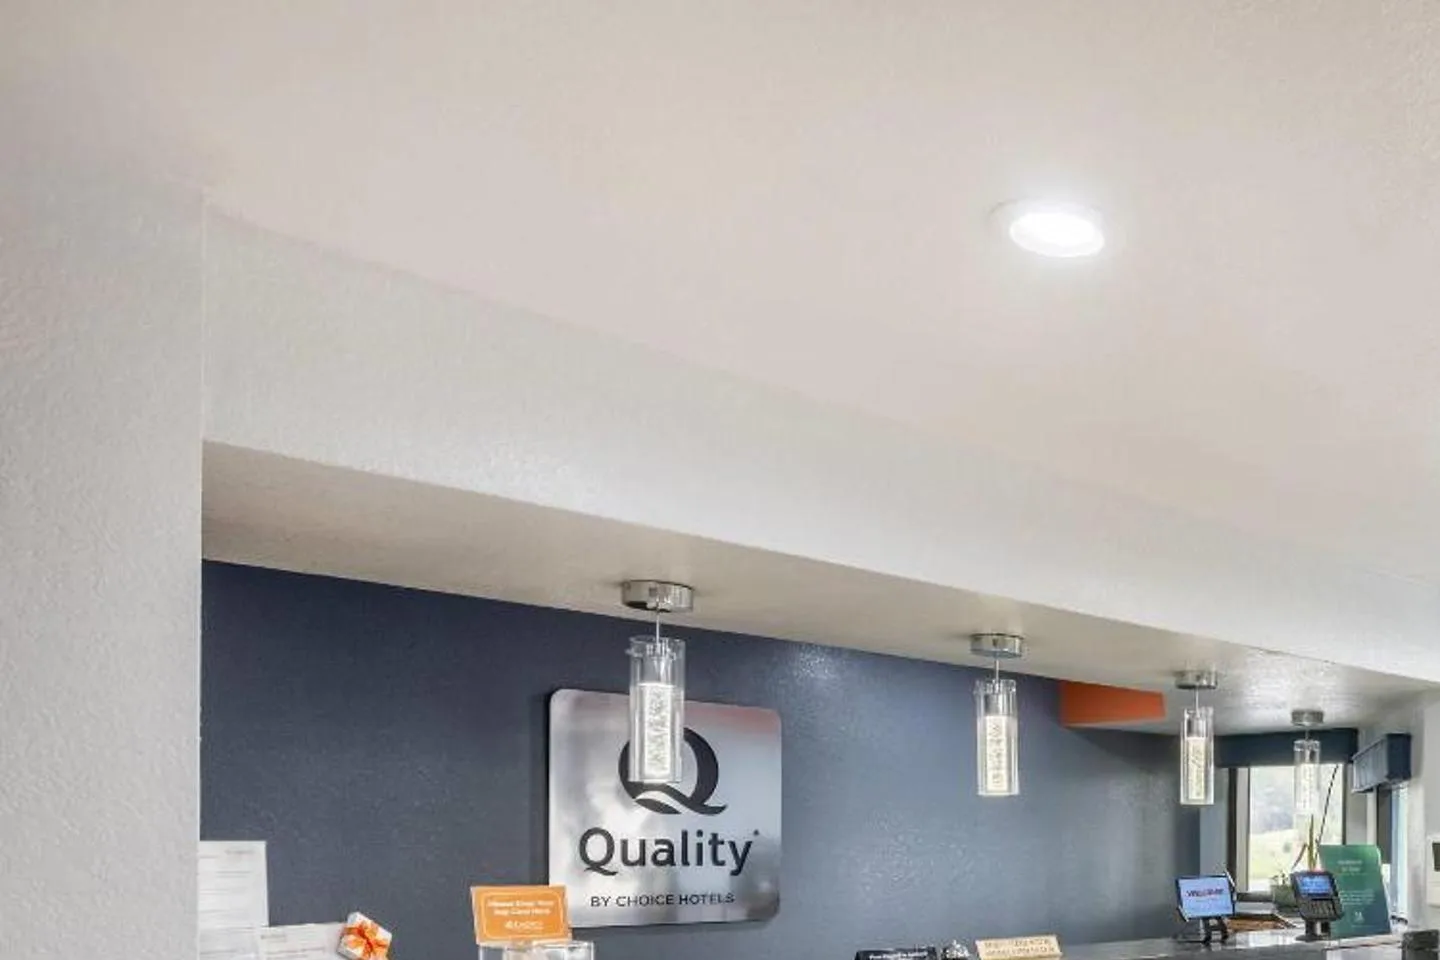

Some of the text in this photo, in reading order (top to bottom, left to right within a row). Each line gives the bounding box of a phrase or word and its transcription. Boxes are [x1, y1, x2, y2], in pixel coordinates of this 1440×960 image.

[579, 827, 753, 876] Quality
[590, 892, 735, 908] BY CHOICE HOTELS
